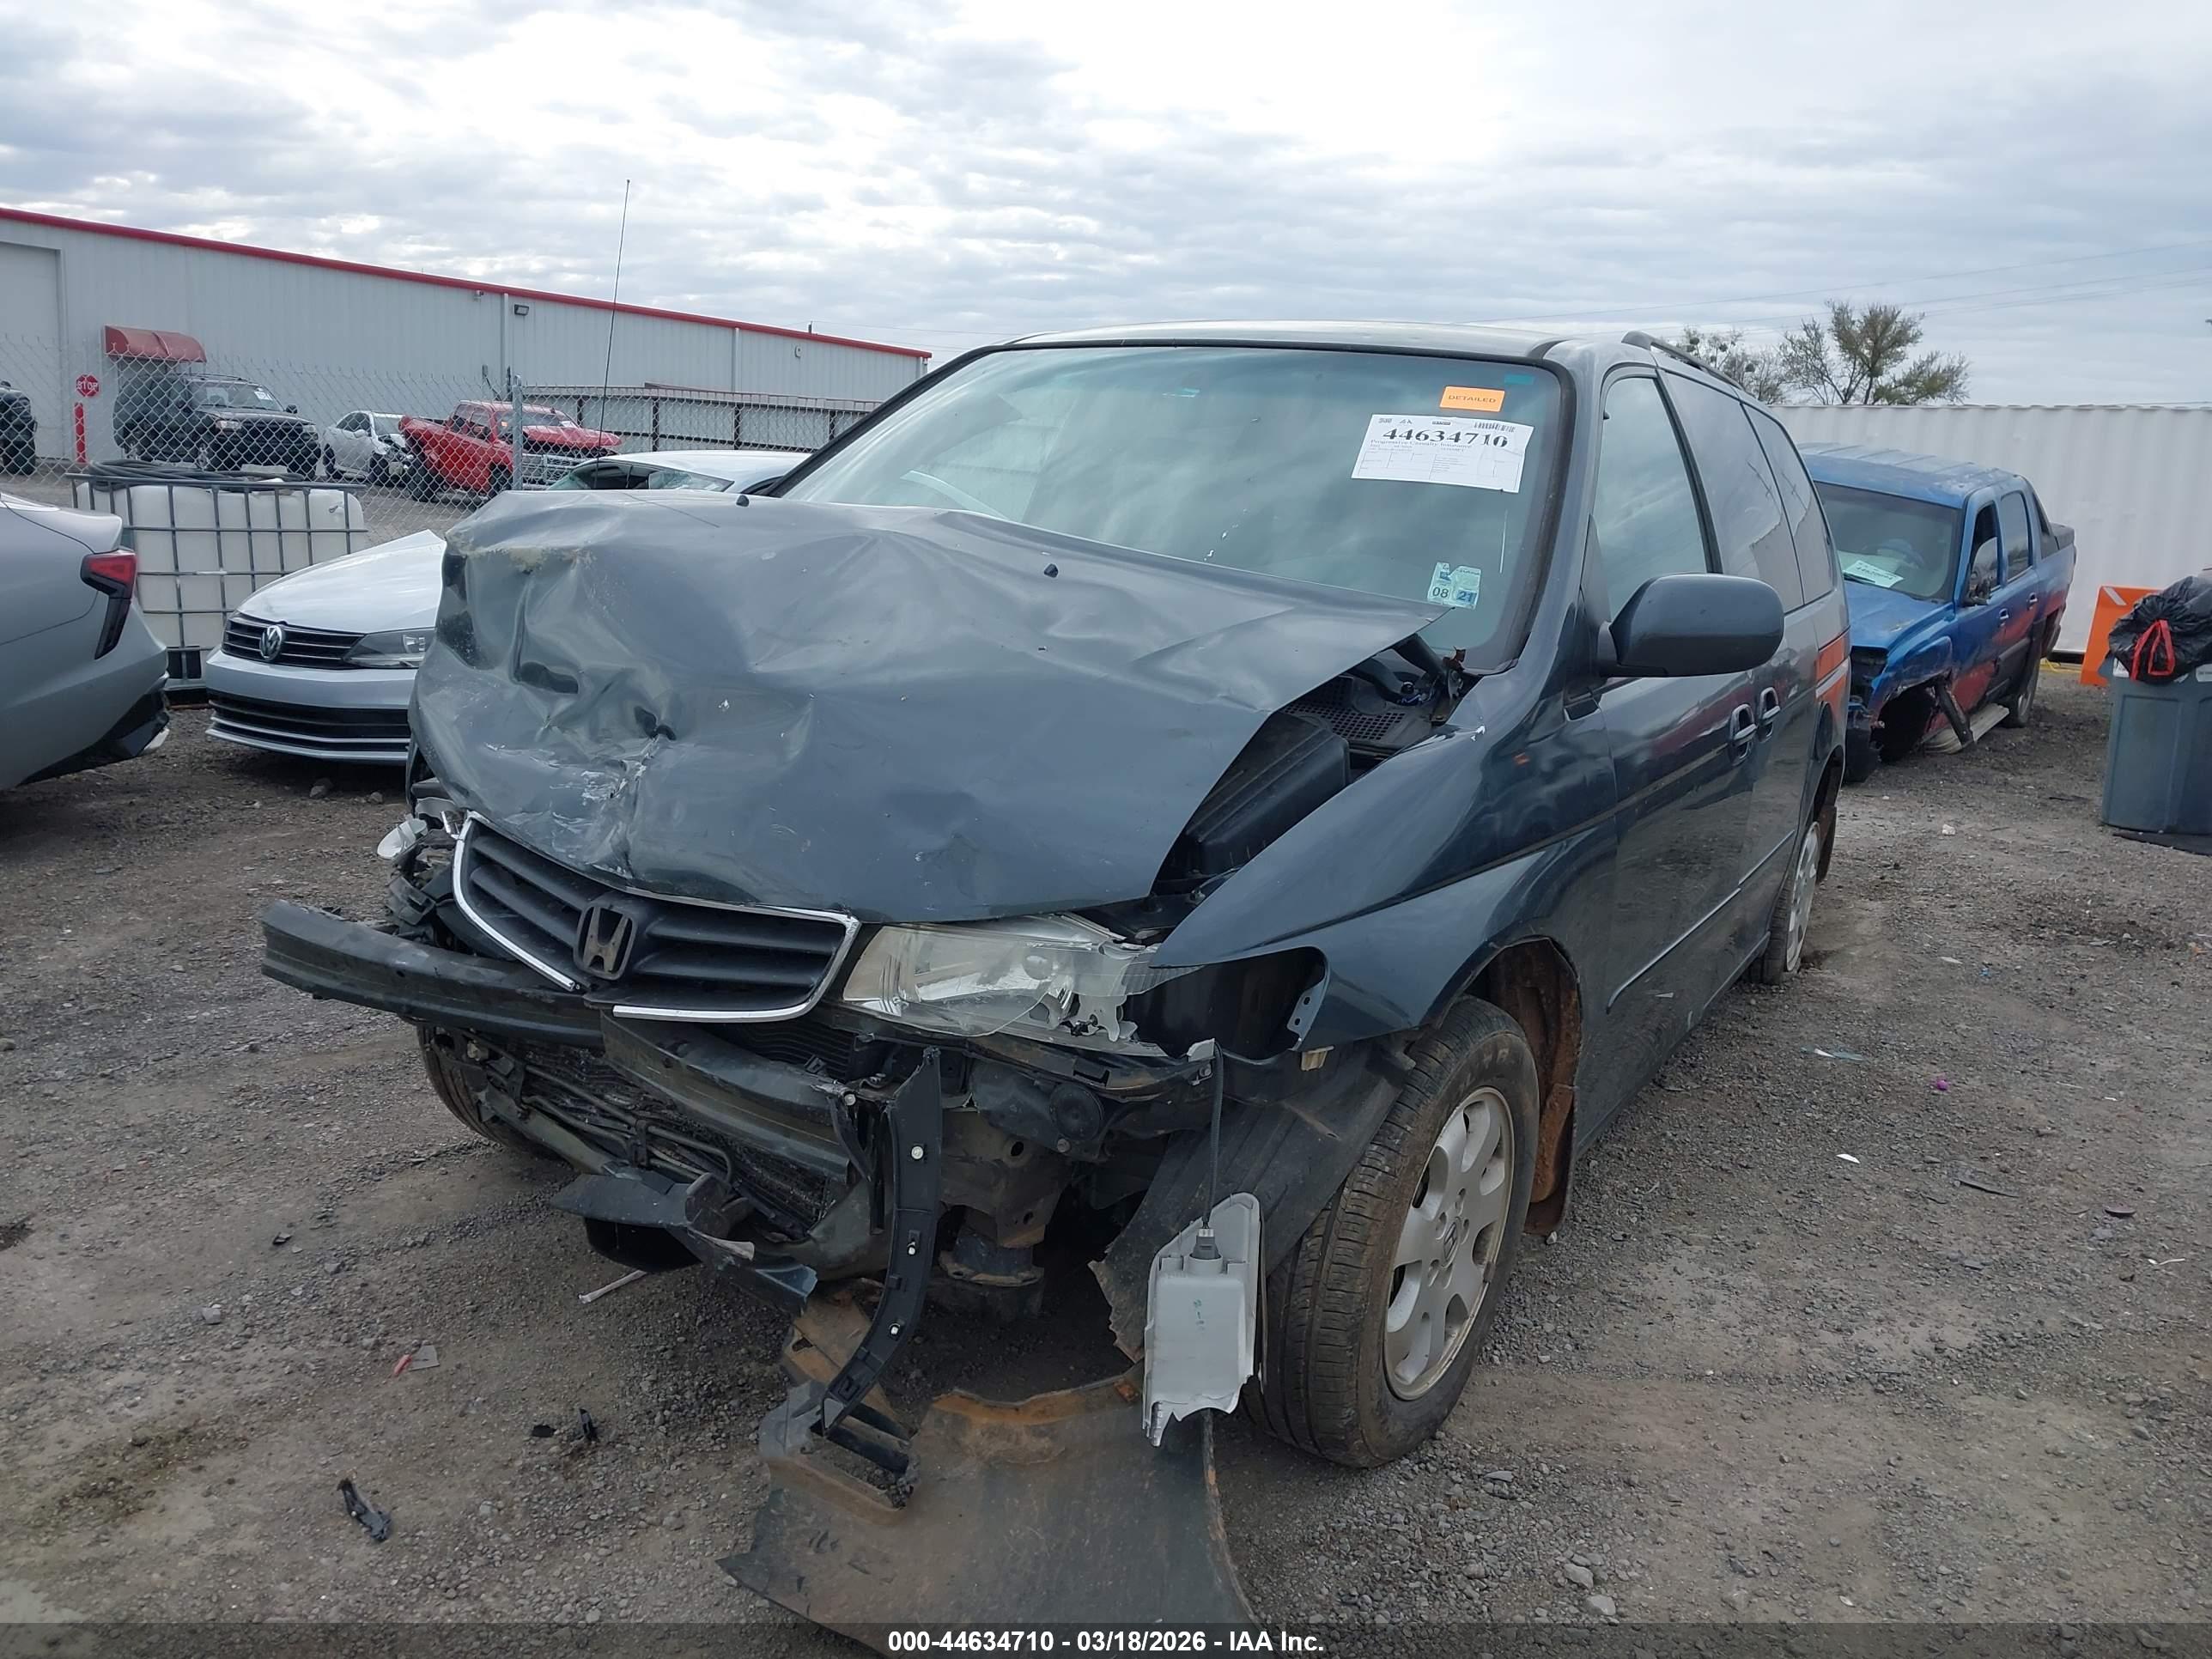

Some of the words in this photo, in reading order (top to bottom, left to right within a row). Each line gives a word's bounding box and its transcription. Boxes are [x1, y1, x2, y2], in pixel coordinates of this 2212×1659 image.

[77, 380, 98, 390] STOP
[1448, 394, 1497, 404] DETAILED
[1382, 428, 1508, 447] 44634710
[1432, 586, 1449, 599] 08
